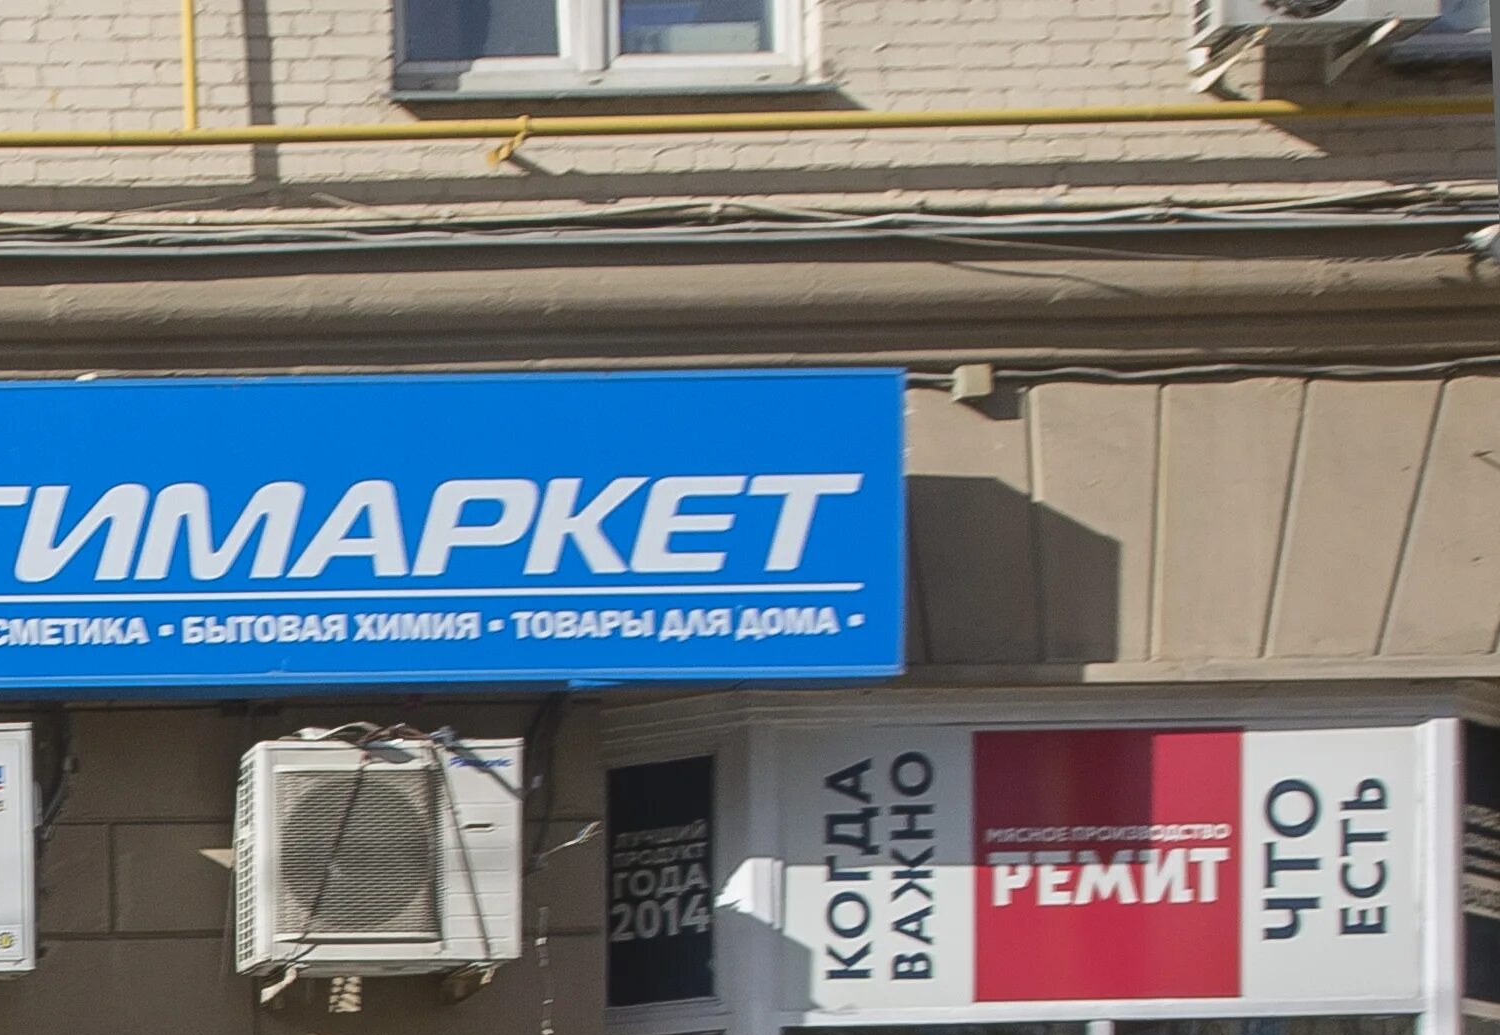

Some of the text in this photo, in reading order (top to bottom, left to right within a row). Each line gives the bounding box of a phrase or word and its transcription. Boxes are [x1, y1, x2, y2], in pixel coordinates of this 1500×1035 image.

[181, 612, 348, 645] БЫТОВАЯ
[353, 611, 481, 642] ХИМИЯ
[511, 608, 655, 640] ТОВАРЫ
[658, 608, 731, 642] ДЛЯ
[734, 606, 841, 641] ДОМА
[612, 862, 709, 900] ГОДА
[826, 758, 874, 980] КОГДА
[889, 751, 934, 980] ВАЖНО
[988, 847, 1231, 906] РЕМИТ
[1263, 778, 1321, 940] ЧТО
[1339, 778, 1388, 935] ЕСТЬ
[610, 894, 711, 942] 2014
